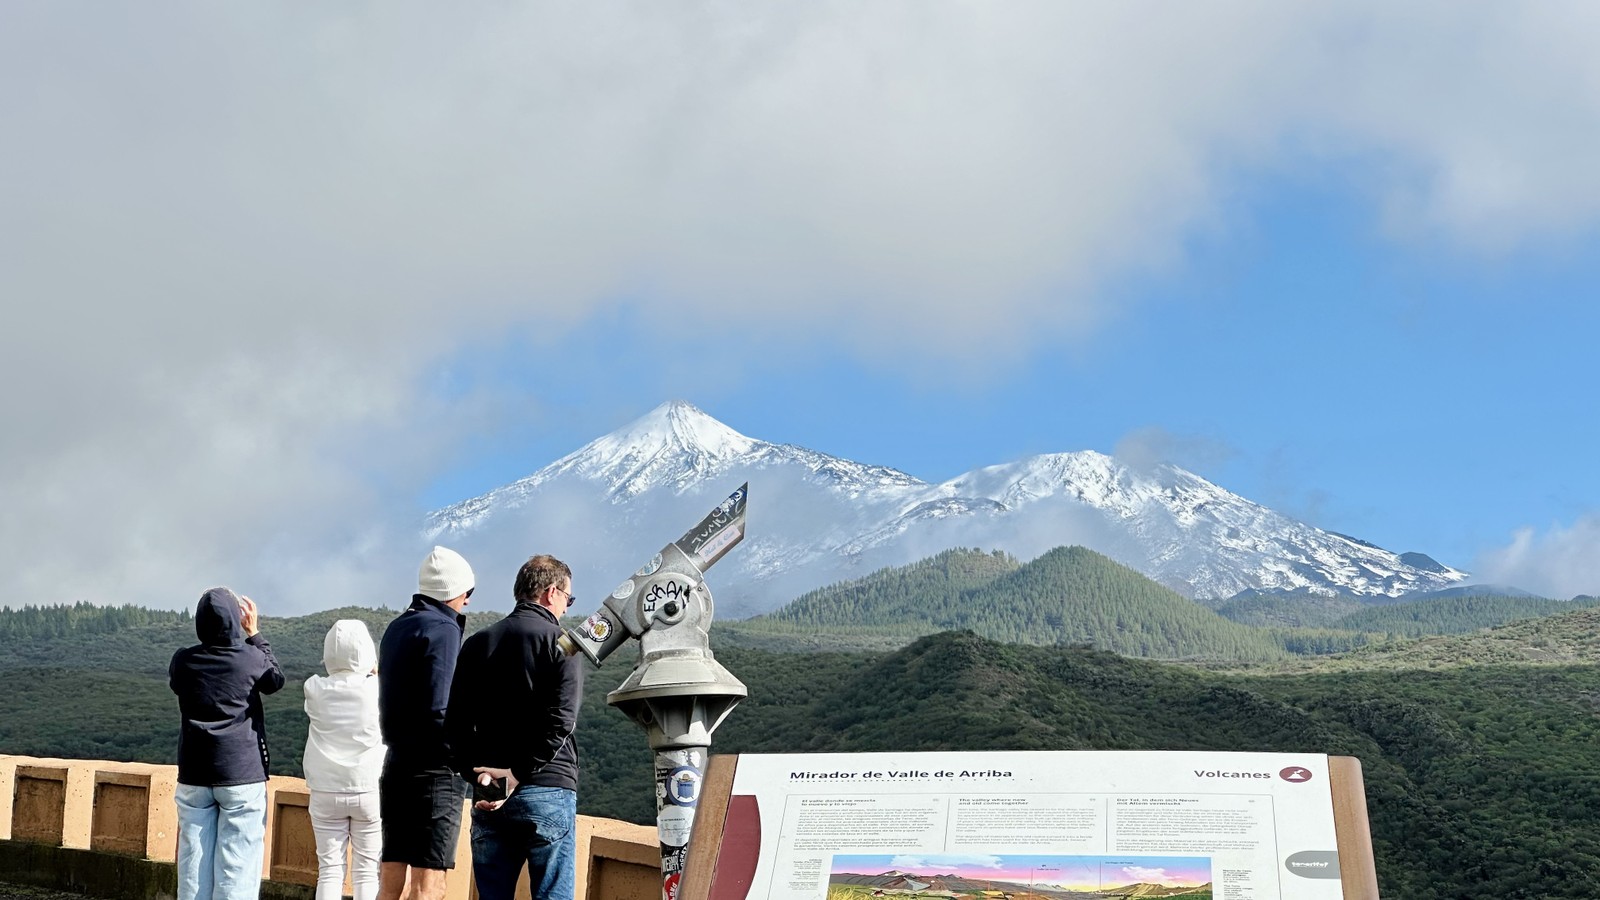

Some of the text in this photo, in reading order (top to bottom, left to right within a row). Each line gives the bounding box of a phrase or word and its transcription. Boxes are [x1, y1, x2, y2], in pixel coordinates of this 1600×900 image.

[790, 770, 1012, 779] Mirador de Valle de Arriba
[1193, 770, 1271, 779] Volcanes
